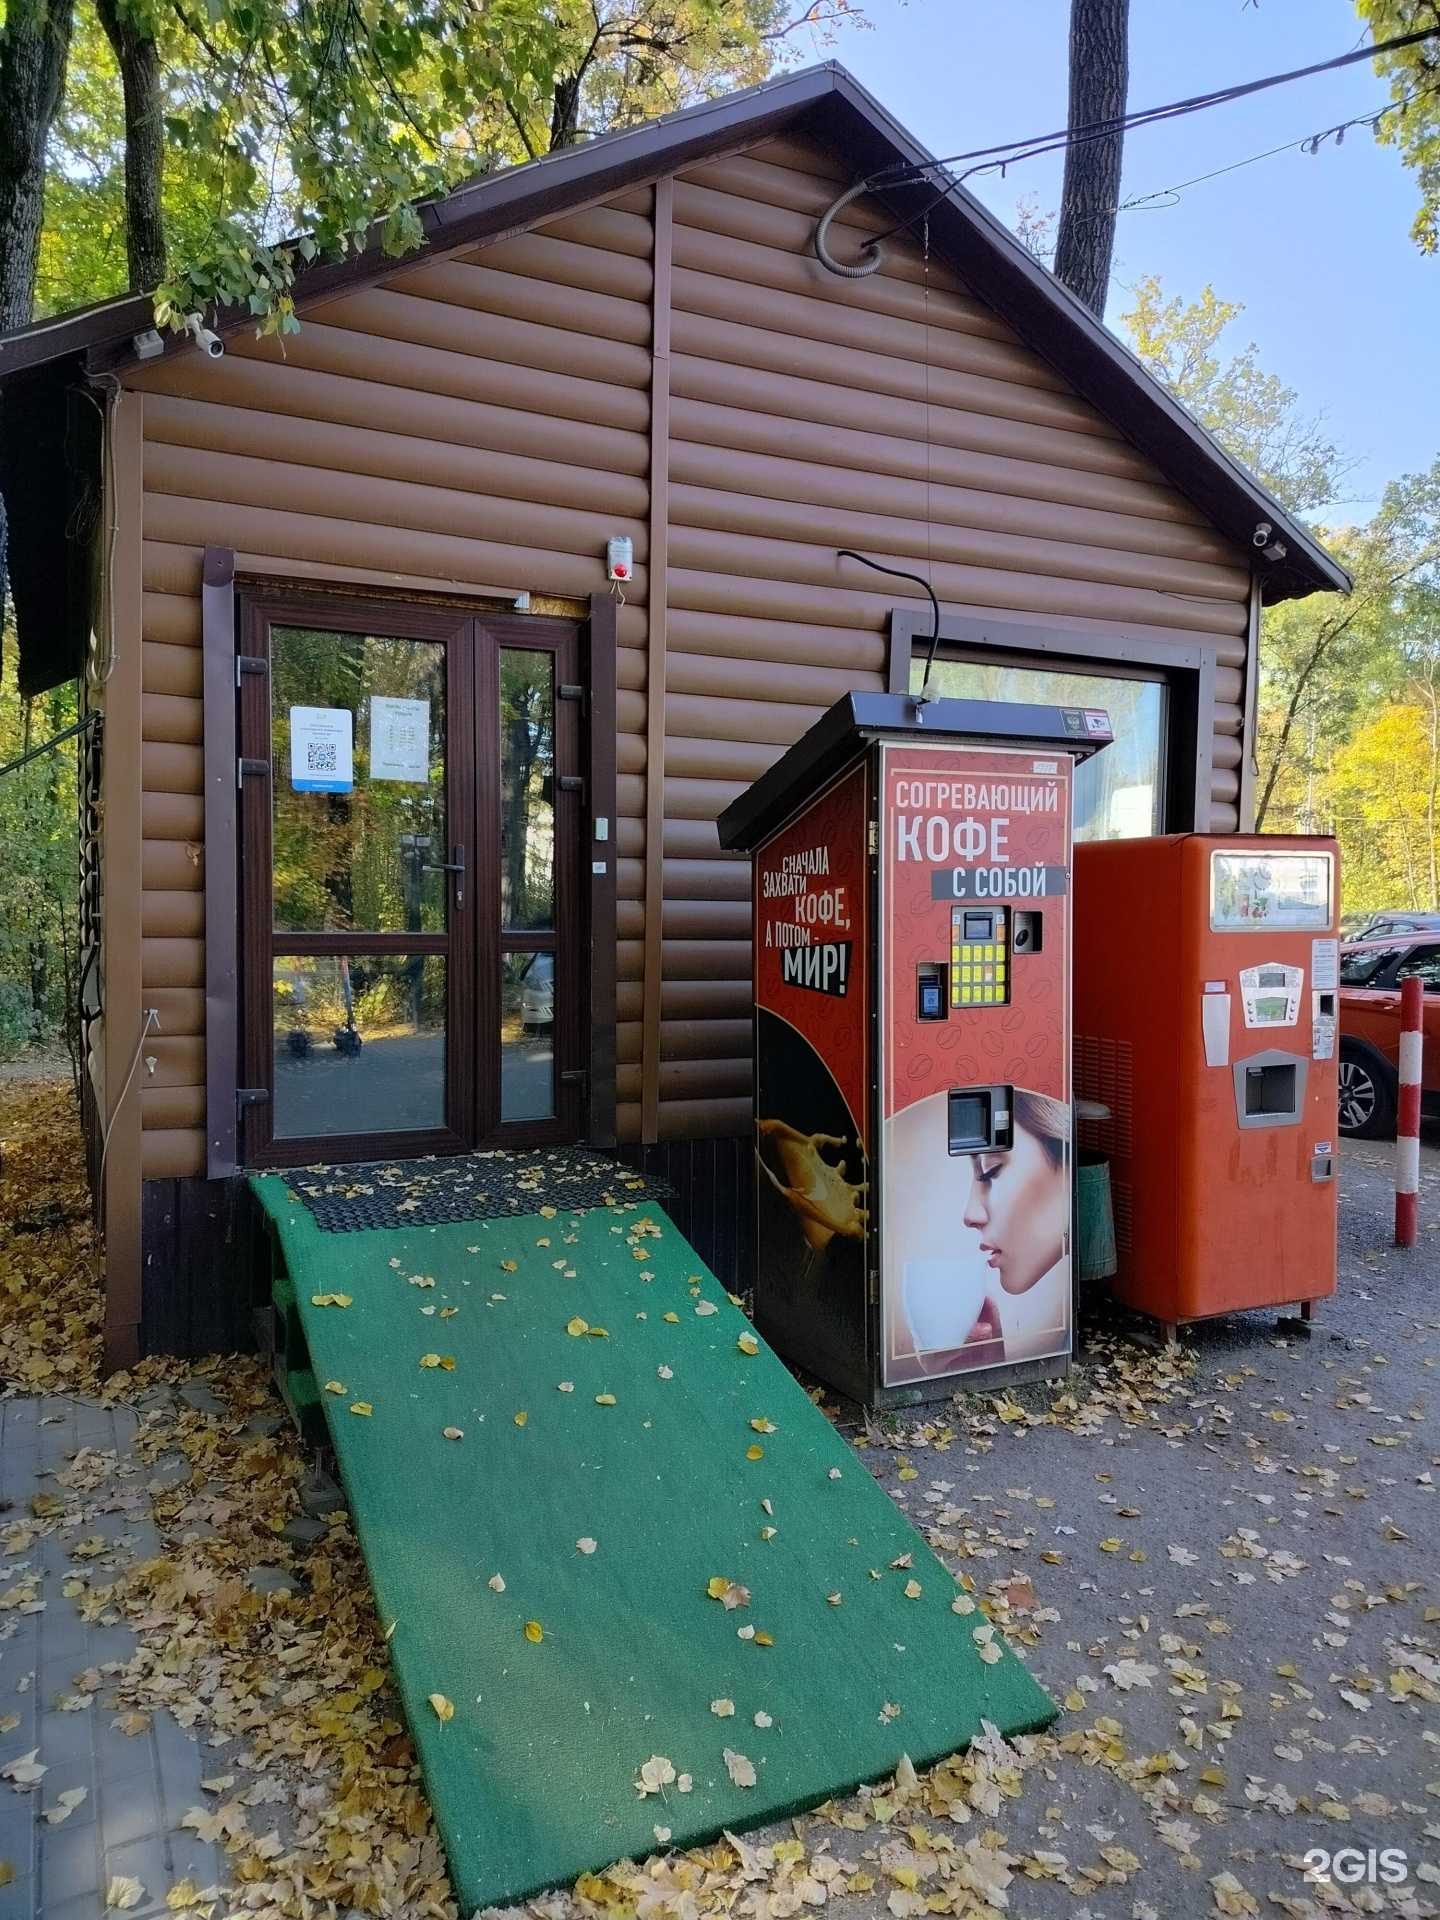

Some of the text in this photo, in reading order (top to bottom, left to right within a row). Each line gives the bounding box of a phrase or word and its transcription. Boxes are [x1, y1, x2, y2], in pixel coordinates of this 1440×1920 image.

[896, 781, 1058, 814] СОГРЕВАЮЩИЙ
[898, 815, 1010, 862] КОФЕ
[782, 846, 829, 875] СНАЧАЛА
[763, 871, 807, 898] ЗАХВАТИ
[953, 862, 1046, 897] С СОБОЙ
[795, 887, 850, 930] КОФЕ,
[765, 920, 772, 947] А
[775, 921, 810, 947] ПОТОМ
[784, 943, 846, 994] МИР!
